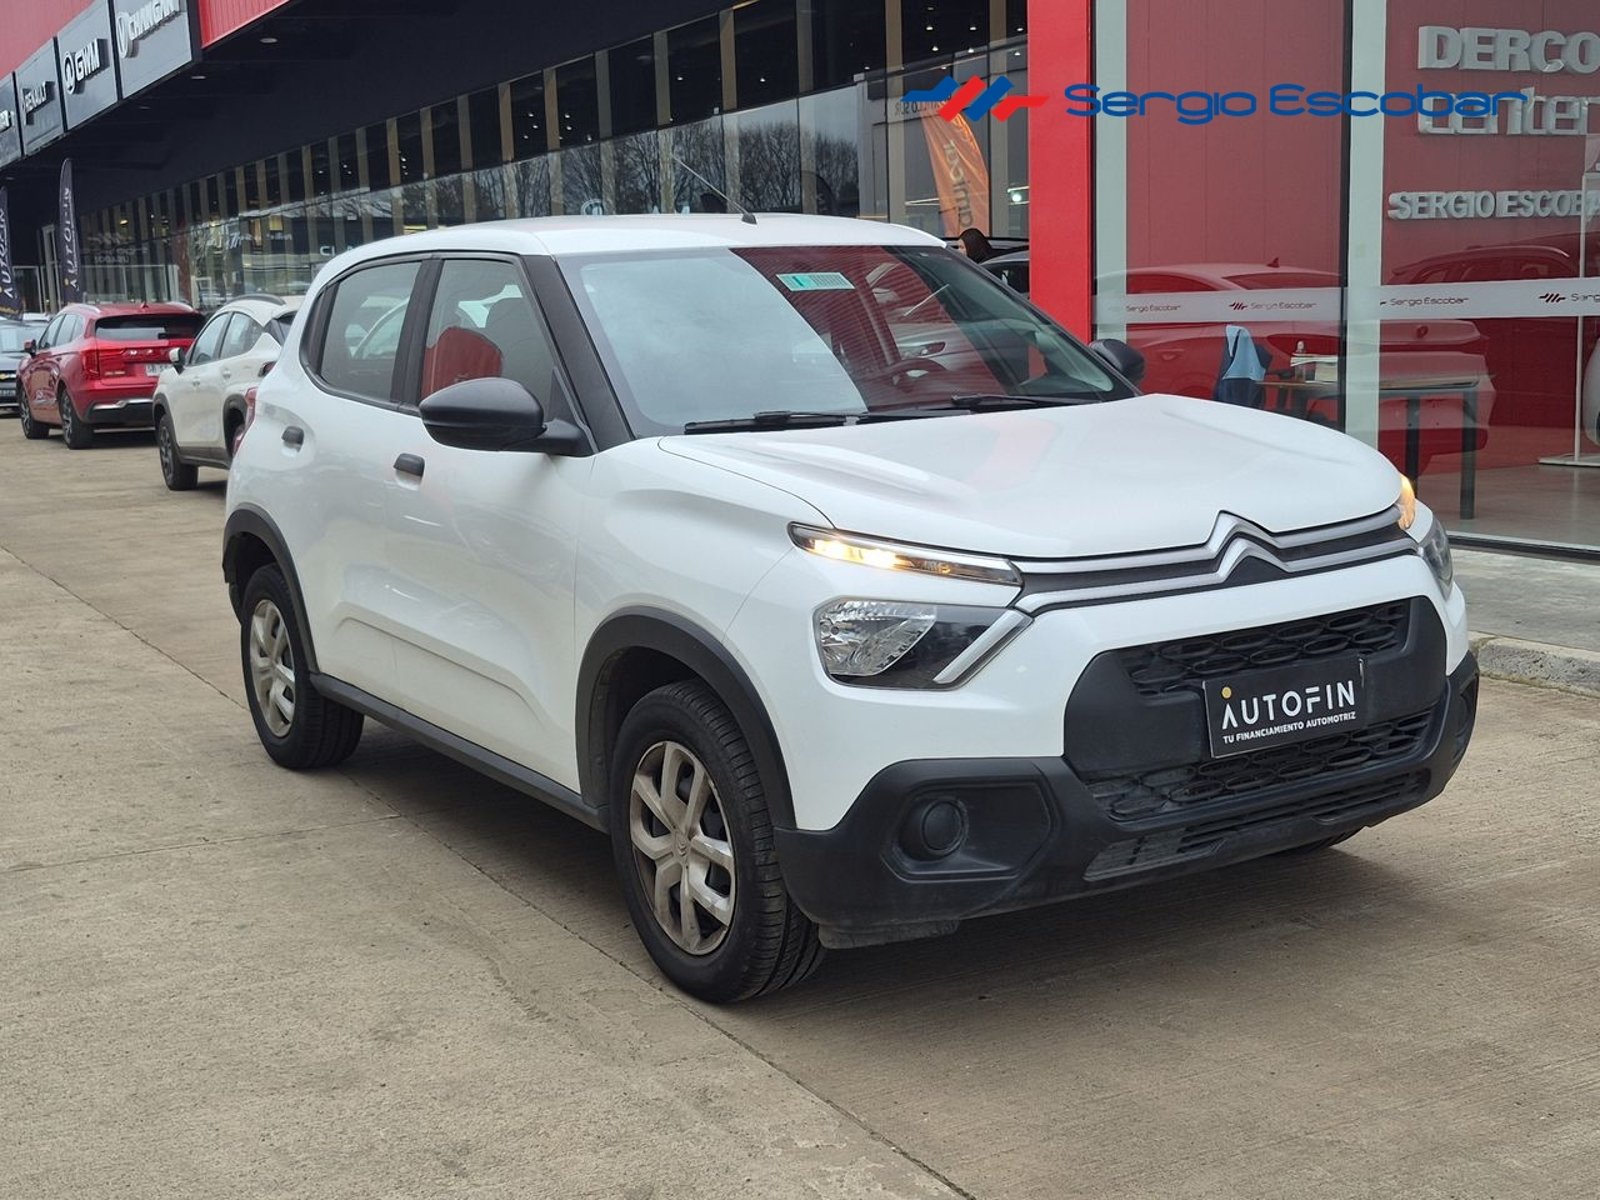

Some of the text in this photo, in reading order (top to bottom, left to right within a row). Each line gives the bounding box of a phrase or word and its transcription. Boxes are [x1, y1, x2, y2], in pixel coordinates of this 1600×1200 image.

[75, 38, 101, 82] GWM
[1418, 26, 1600, 73] DERCO
[1388, 191, 1496, 219] SERGIO
[1424, 296, 1469, 305] Escobar
[1222, 680, 1355, 730] AUTOFIN
[1223, 711, 1357, 744] TU FINANCIAMIENTO AUTOMOTRIZ
